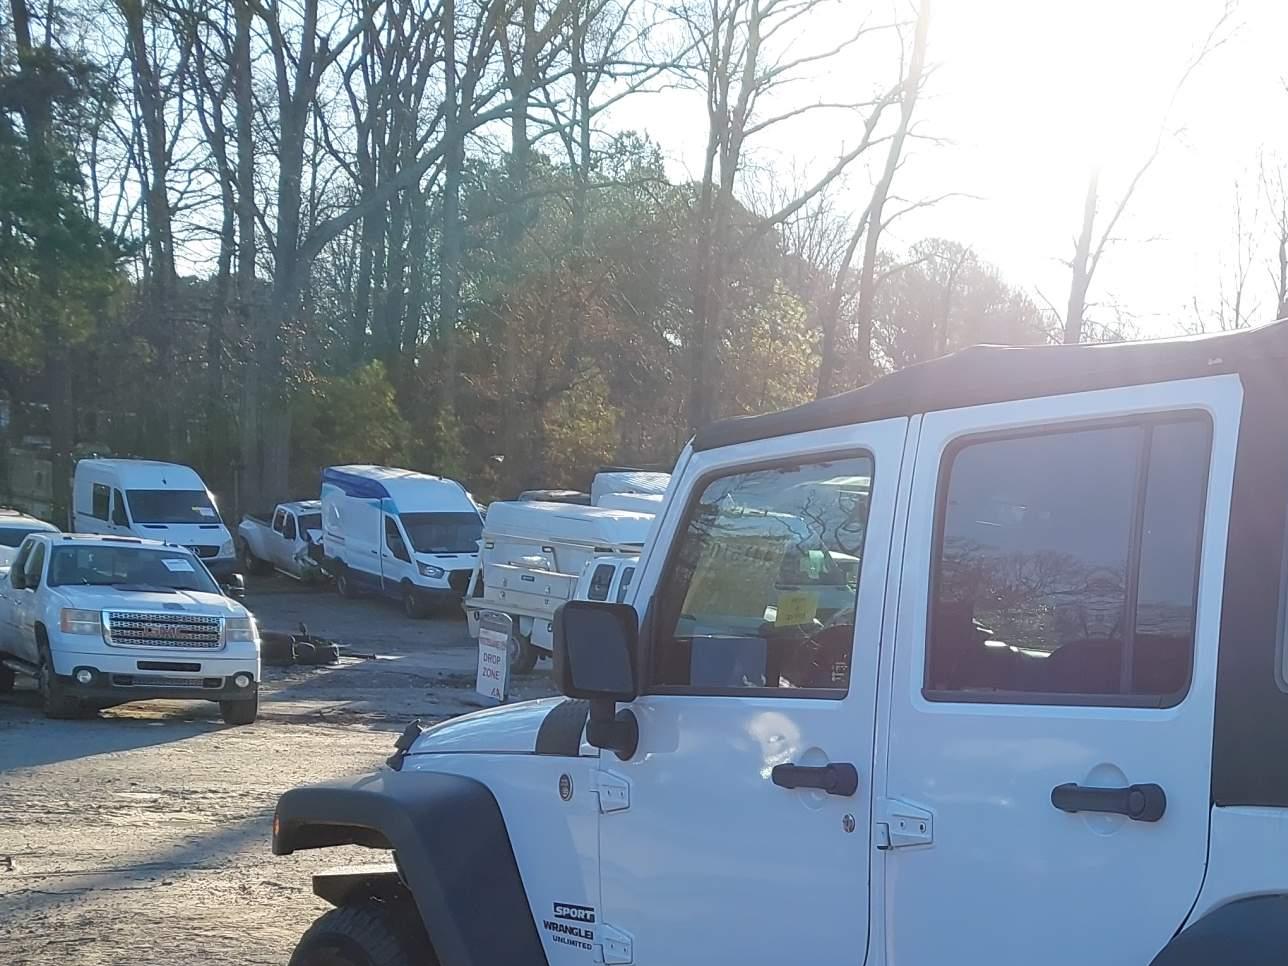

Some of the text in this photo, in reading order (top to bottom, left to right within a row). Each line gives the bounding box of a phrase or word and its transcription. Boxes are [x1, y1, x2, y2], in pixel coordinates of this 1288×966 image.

[142, 625, 191, 639] GMC
[483, 652, 501, 665] DROP
[482, 667, 501, 680] ZONE
[555, 905, 594, 921] SPORT
[552, 935, 593, 950] UNLIMITED
